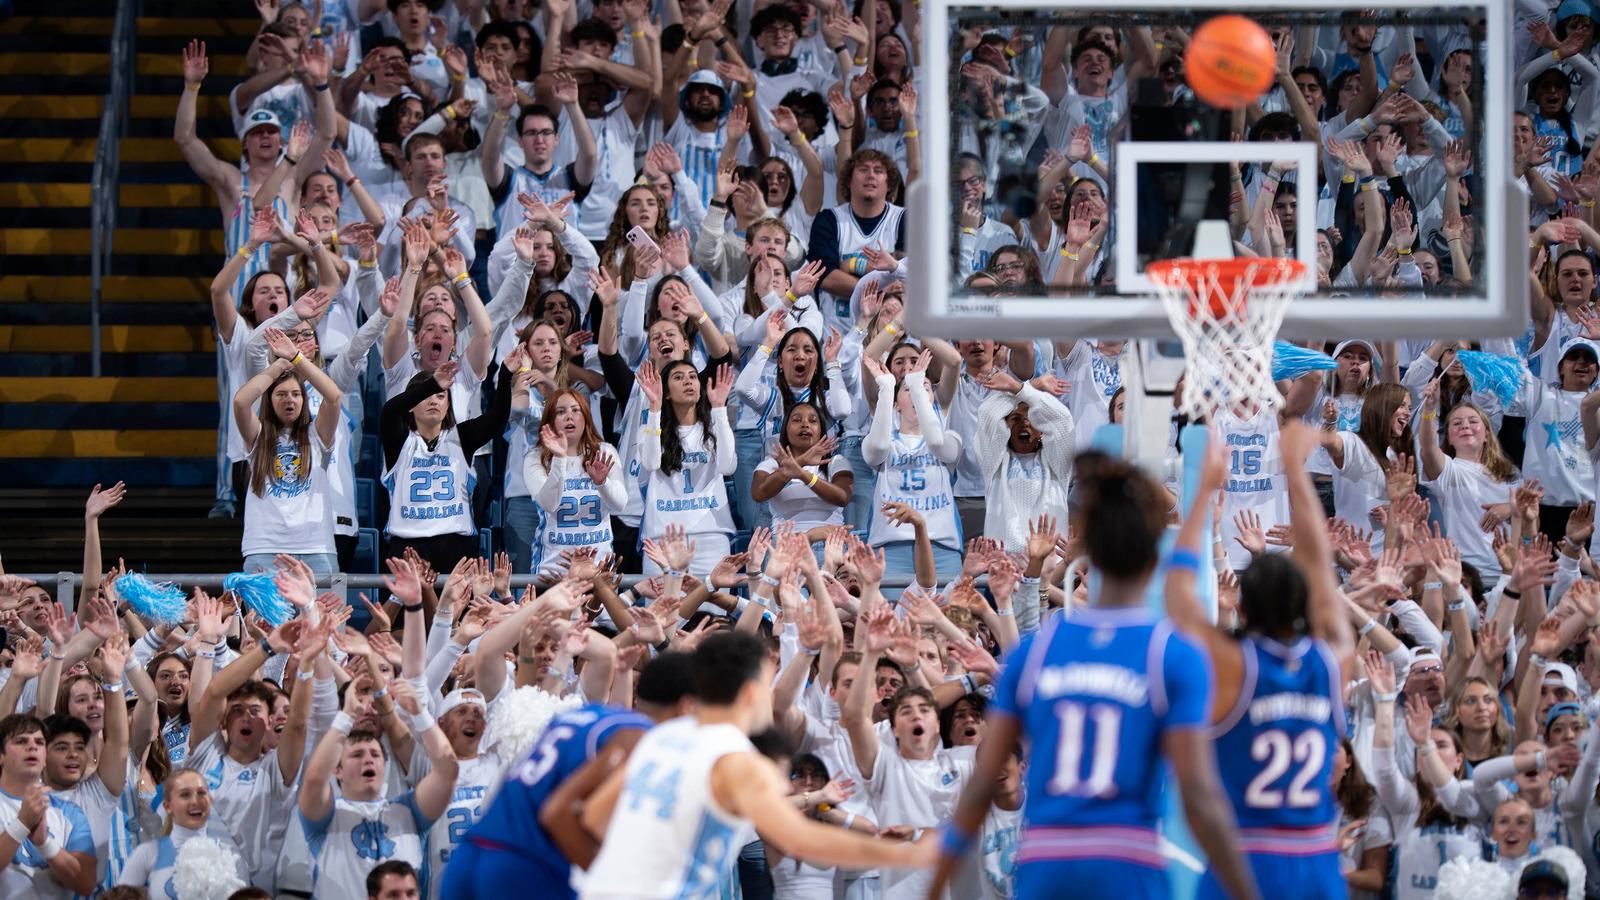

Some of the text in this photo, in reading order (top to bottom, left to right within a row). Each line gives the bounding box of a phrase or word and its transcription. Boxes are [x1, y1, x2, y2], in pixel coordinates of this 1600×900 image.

[1230, 450, 1262, 475] 15
[409, 470, 455, 502] 23
[682, 468, 694, 493] 1
[899, 467, 926, 491] 15
[1222, 478, 1273, 492] AROLINA
[400, 503, 464, 519] CAROLINA
[556, 494, 602, 528] 23
[656, 496, 718, 511] CAROLINA
[548, 528, 611, 546] CAROLINA
[1046, 700, 1122, 798] 11
[1245, 728, 1327, 809] 22
[624, 760, 684, 822] 44
[446, 805, 481, 844] 2
